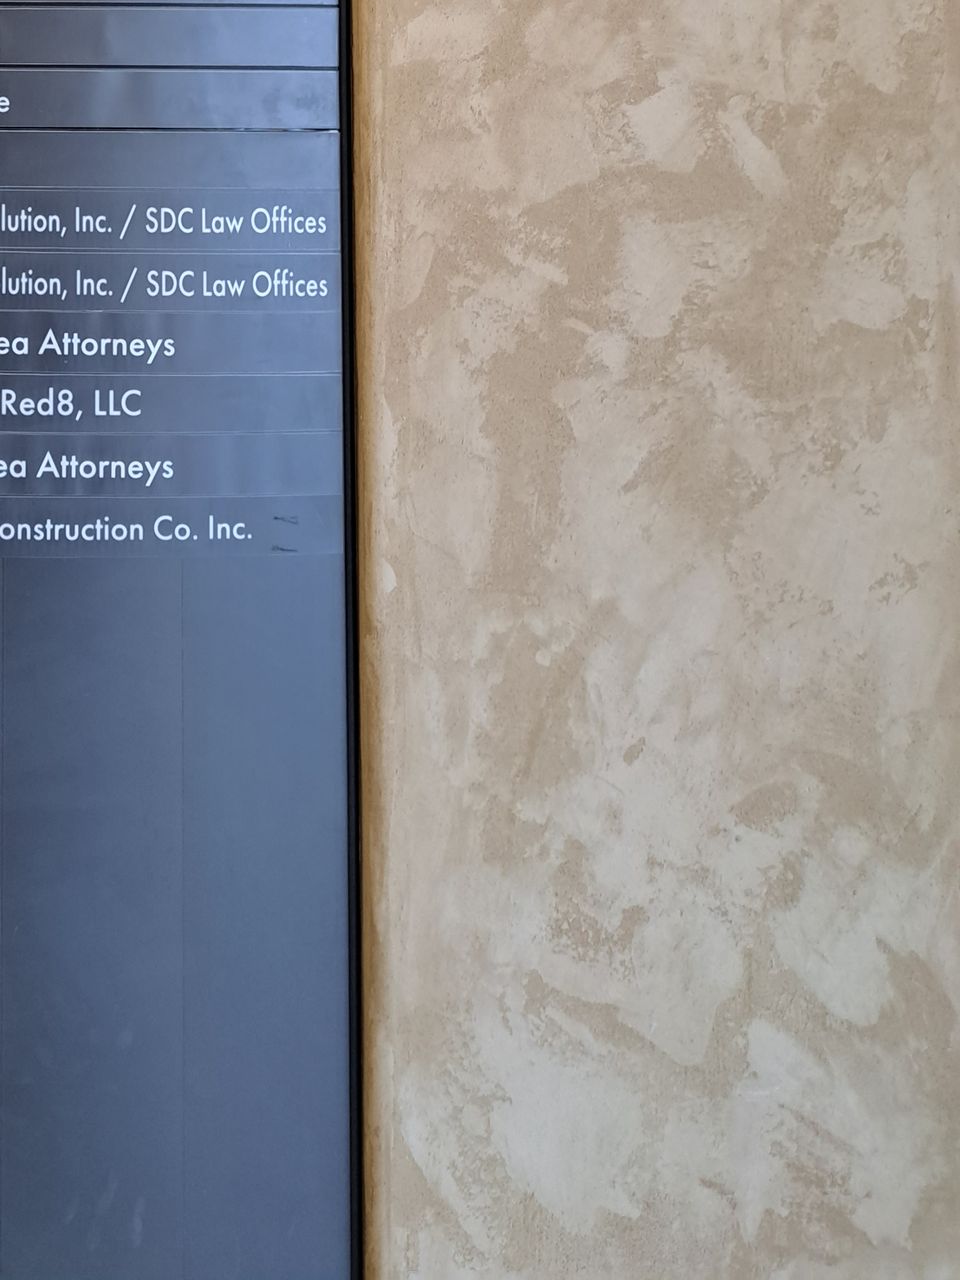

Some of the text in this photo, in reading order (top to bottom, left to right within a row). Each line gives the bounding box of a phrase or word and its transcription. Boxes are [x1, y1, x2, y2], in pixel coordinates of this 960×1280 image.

[75, 206, 113, 233] Inc.
[119, 203, 137, 241] /
[145, 206, 194, 234] SDC
[201, 207, 244, 234] Law
[250, 205, 327, 234] Offices
[75, 269, 114, 297] Inc.
[119, 266, 138, 304] /
[146, 269, 195, 297] SDC
[202, 270, 246, 297] Law
[252, 268, 329, 298] Offices
[37, 327, 176, 365] Attorneys
[0, 386, 83, 422] Red8,
[94, 389, 142, 417] LLC
[35, 450, 174, 488] Attorneys
[153, 514, 198, 541] Co.
[208, 514, 253, 540] Inc.
